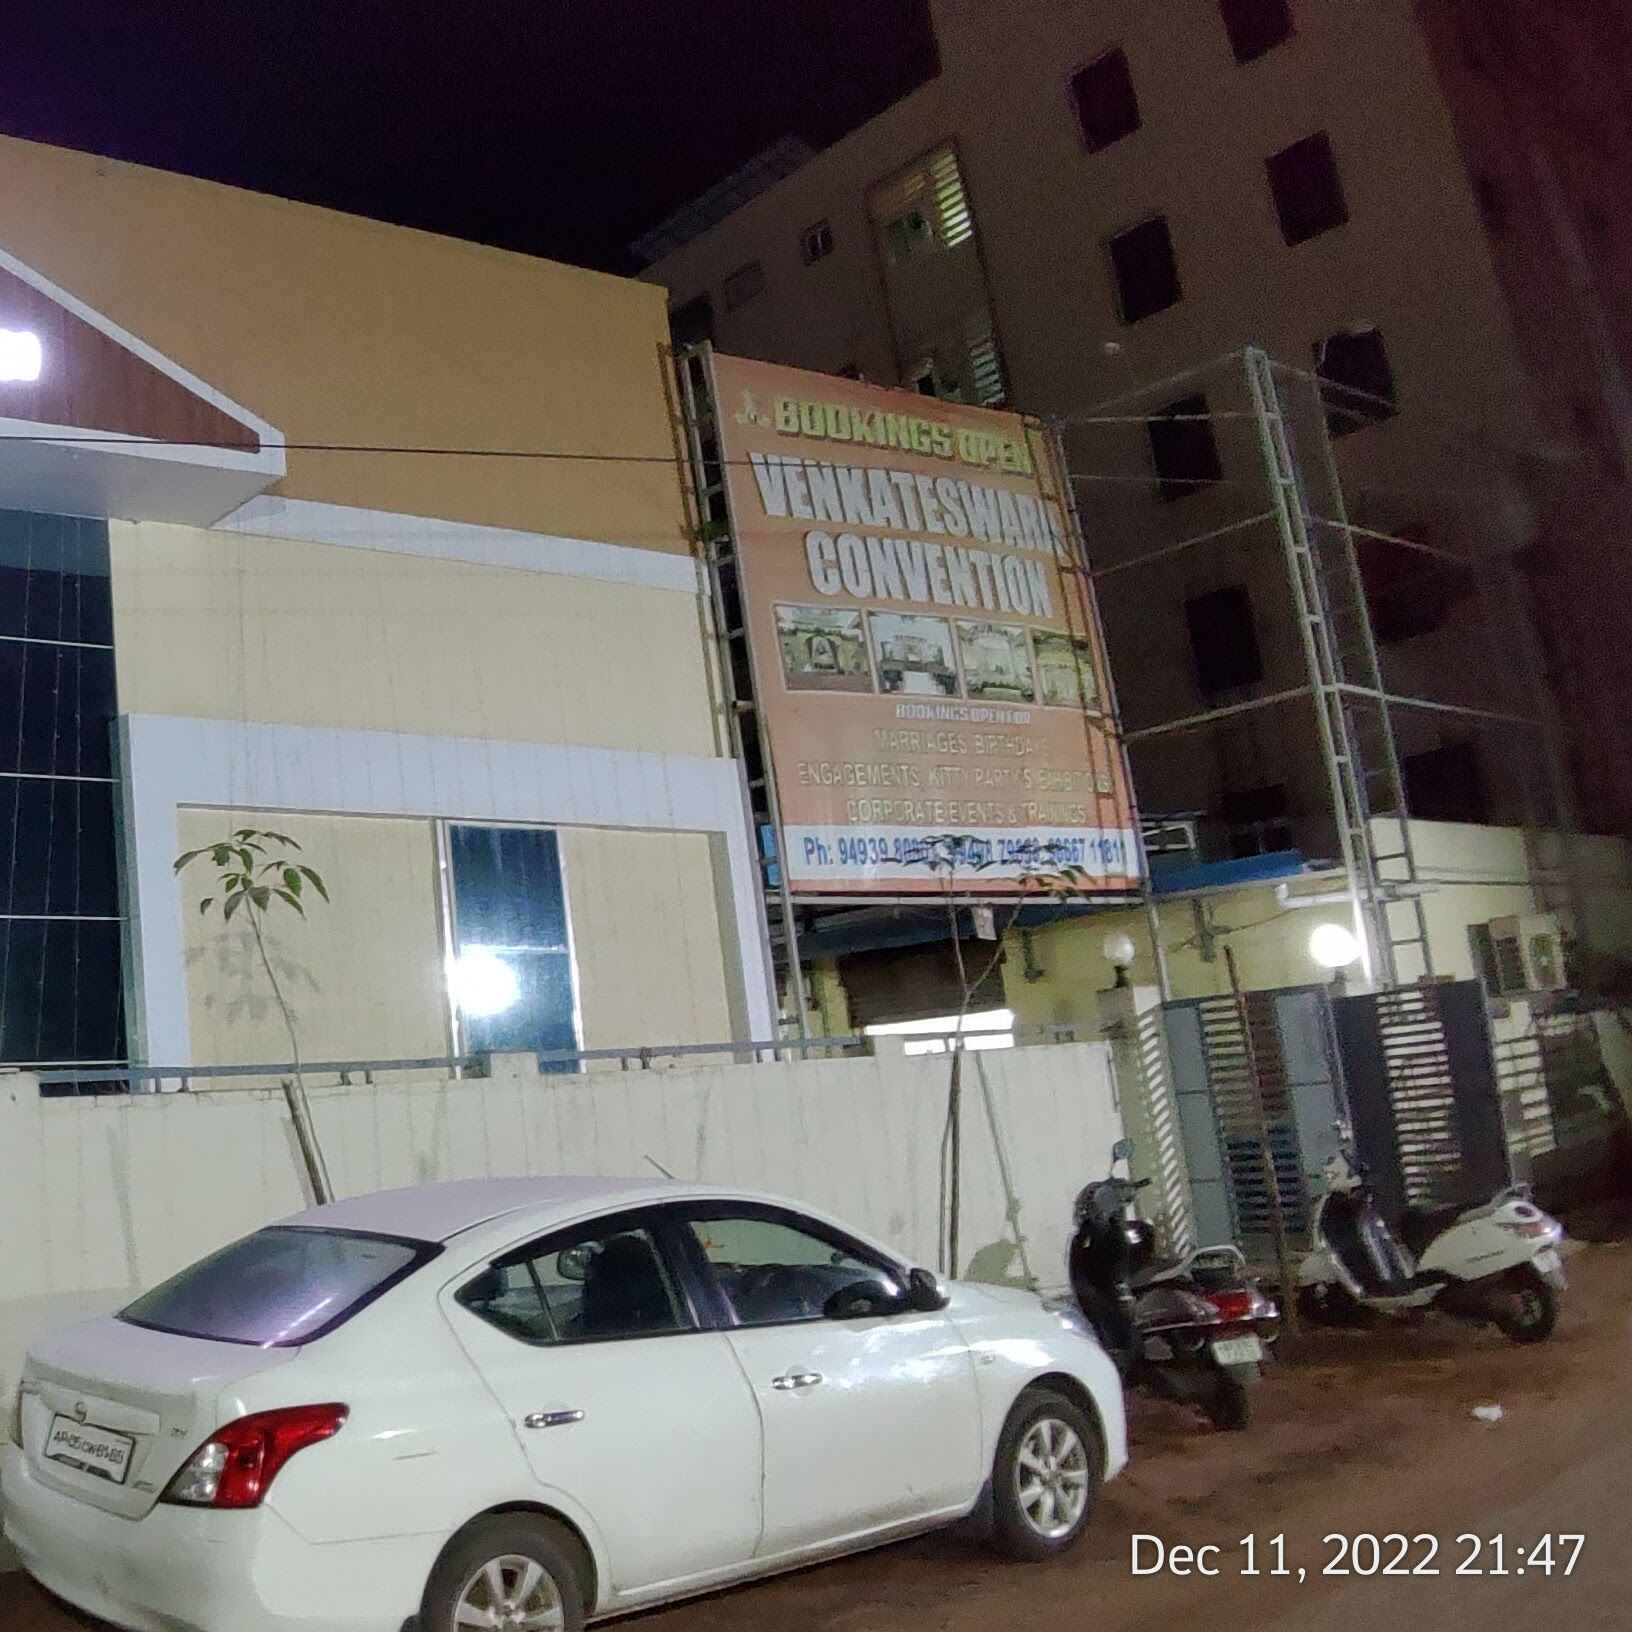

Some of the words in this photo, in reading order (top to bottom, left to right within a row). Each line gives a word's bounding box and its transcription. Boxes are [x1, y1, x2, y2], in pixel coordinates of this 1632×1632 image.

[775, 397, 953, 459] BOOKINGS
[956, 428, 1034, 475] OPEN
[804, 530, 1054, 619] CONVENTION
[803, 837, 834, 866] Ph:
[837, 837, 888, 866] 94939
